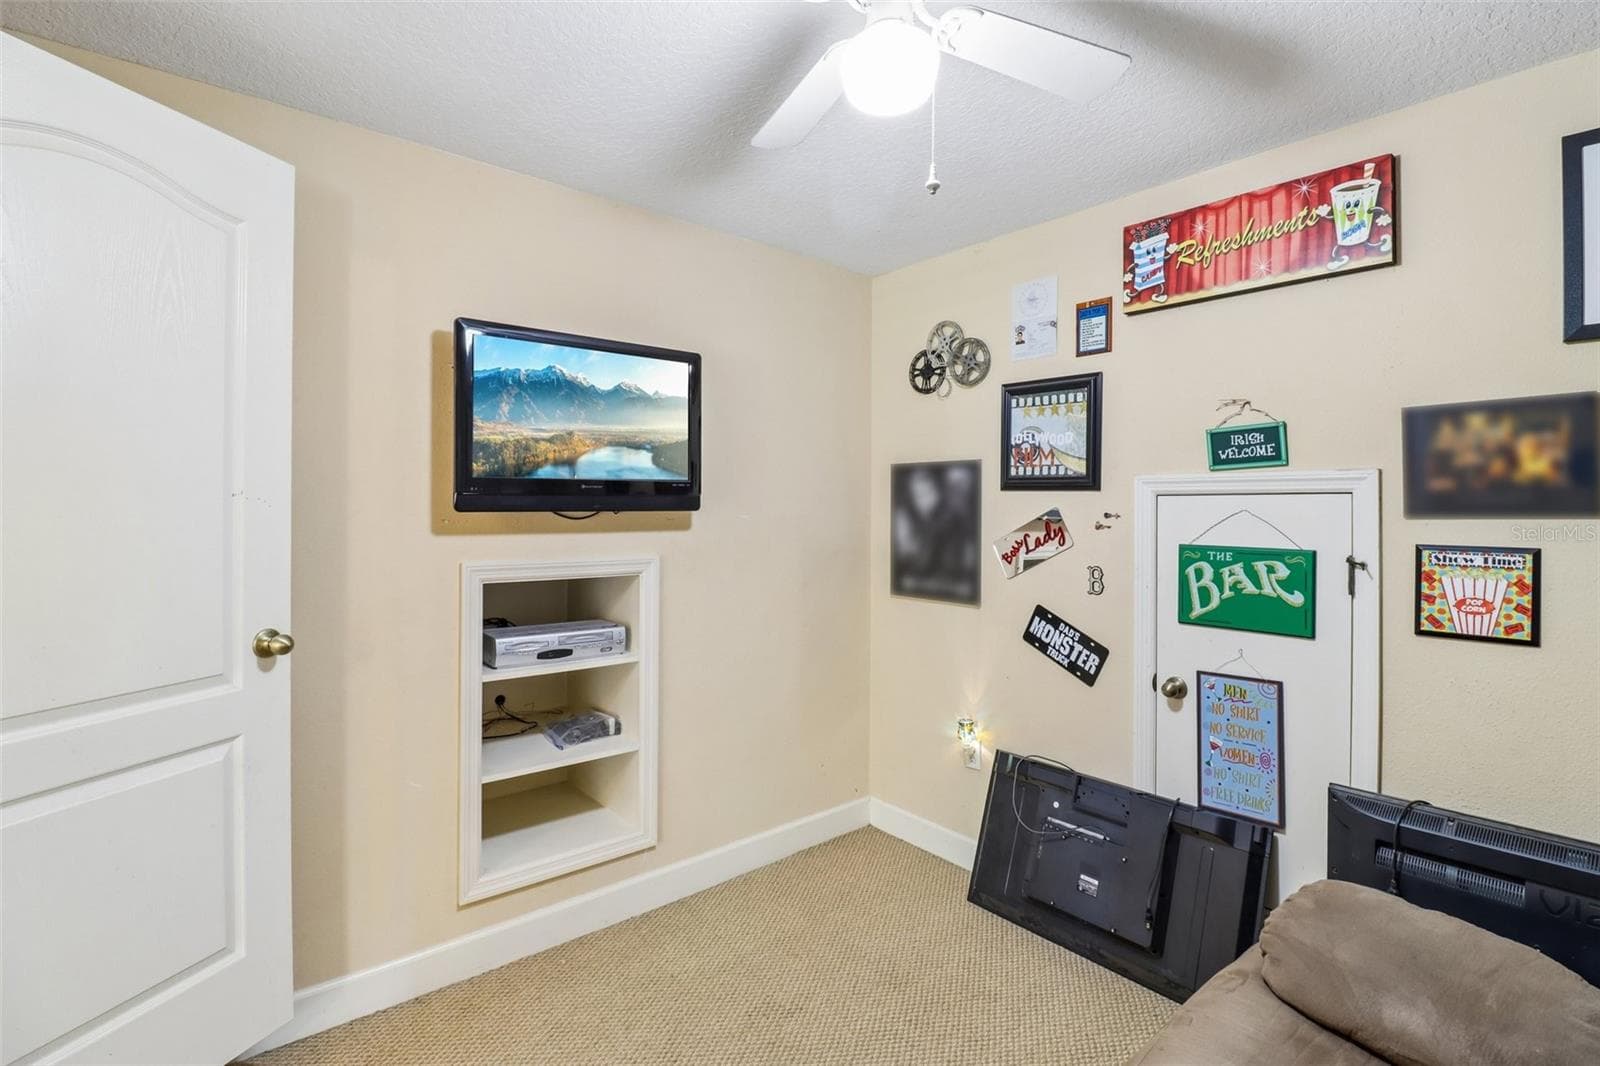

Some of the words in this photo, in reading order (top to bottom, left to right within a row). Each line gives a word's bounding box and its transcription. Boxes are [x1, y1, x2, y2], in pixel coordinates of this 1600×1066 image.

[1175, 205, 1320, 270] Refreshments
[1230, 432, 1265, 446] IRISH
[1218, 443, 1276, 460] WELCOME
[1002, 539, 1023, 565] Boss
[1023, 520, 1066, 554] Lady
[1207, 551, 1233, 562] THE
[1433, 554, 1474, 563] Show
[1185, 560, 1305, 619] BAR
[1461, 605, 1487, 613] CORN
[1058, 622, 1081, 641] DAD'S
[1029, 615, 1100, 675] MONSTER
[1046, 645, 1070, 668] TRUCK
[1223, 683, 1248, 700] MEN
[1211, 702, 1225, 716] NO
[1230, 704, 1261, 722] SHIRT
[1209, 721, 1223, 735] NO
[1226, 723, 1266, 744] SERVICE
[1213, 767, 1228, 781] NO
[1231, 767, 1263, 788] SHIRT
[1210, 787, 1234, 803] FREE
